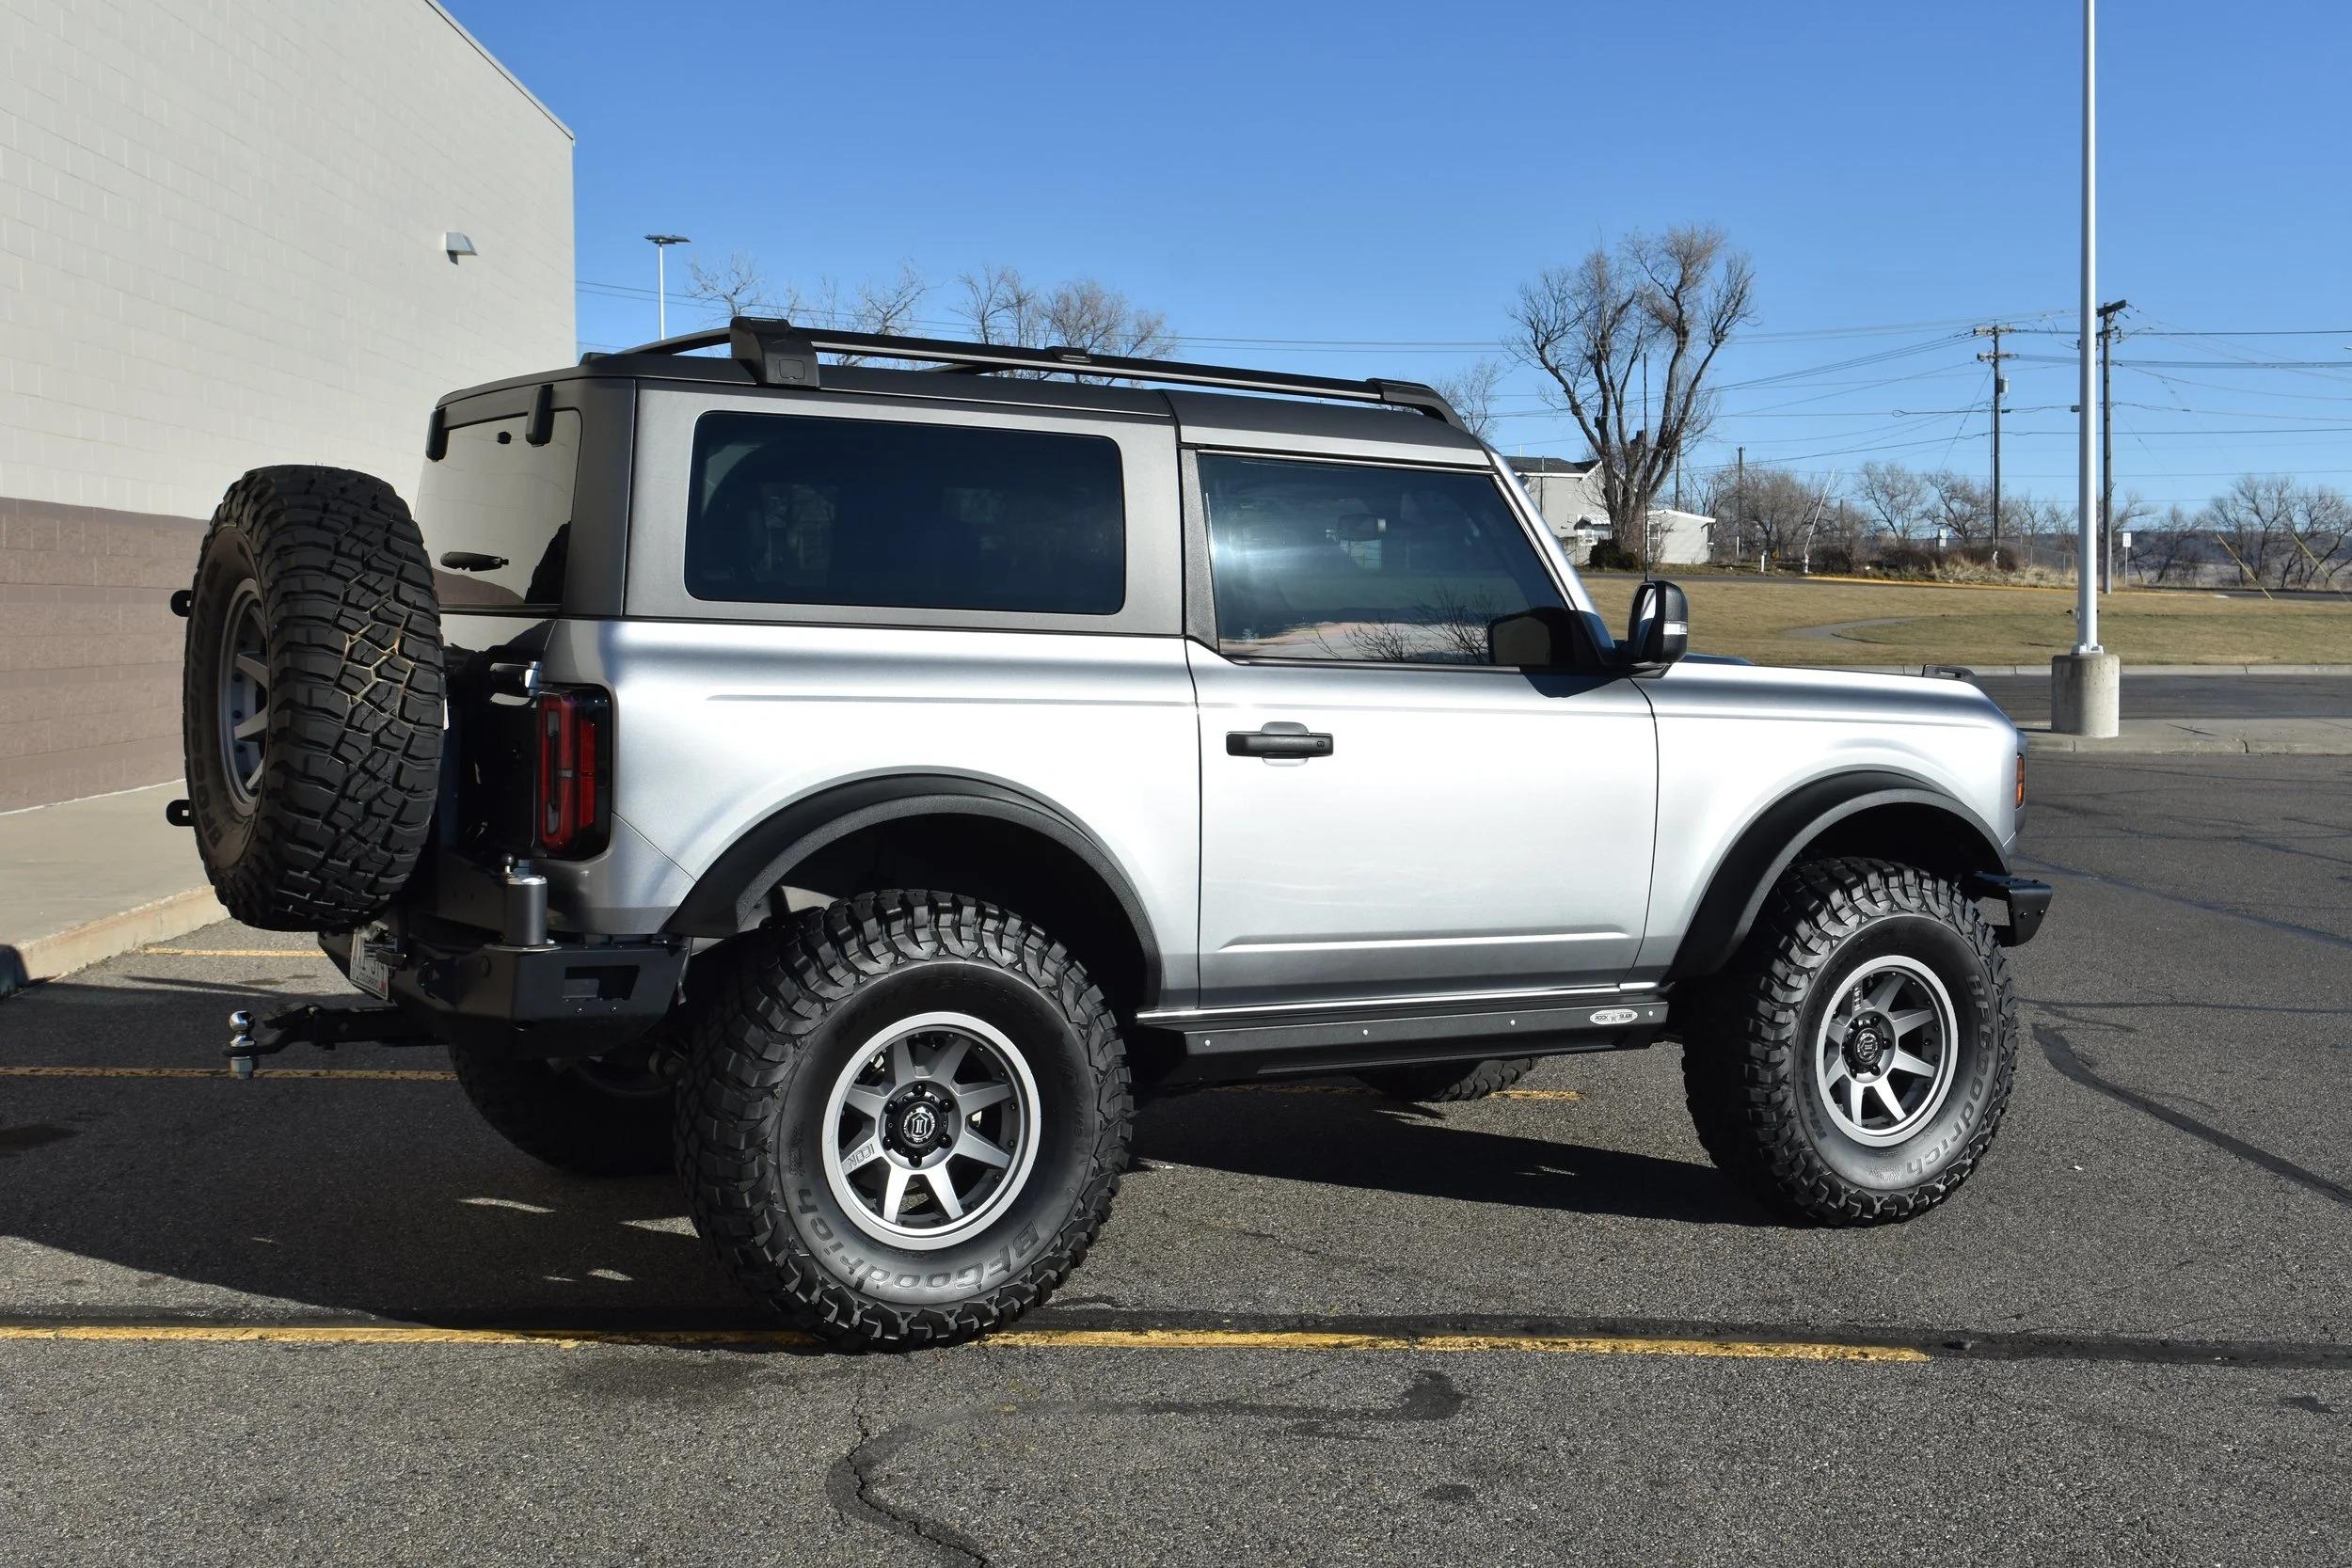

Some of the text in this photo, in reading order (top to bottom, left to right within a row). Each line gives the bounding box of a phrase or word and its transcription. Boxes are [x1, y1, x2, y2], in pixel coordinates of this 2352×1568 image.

[1906, 975, 1993, 1175] BFGoodrich
[847, 1143, 875, 1170] ICON
[798, 1188, 1040, 1290] BFGoodrich
